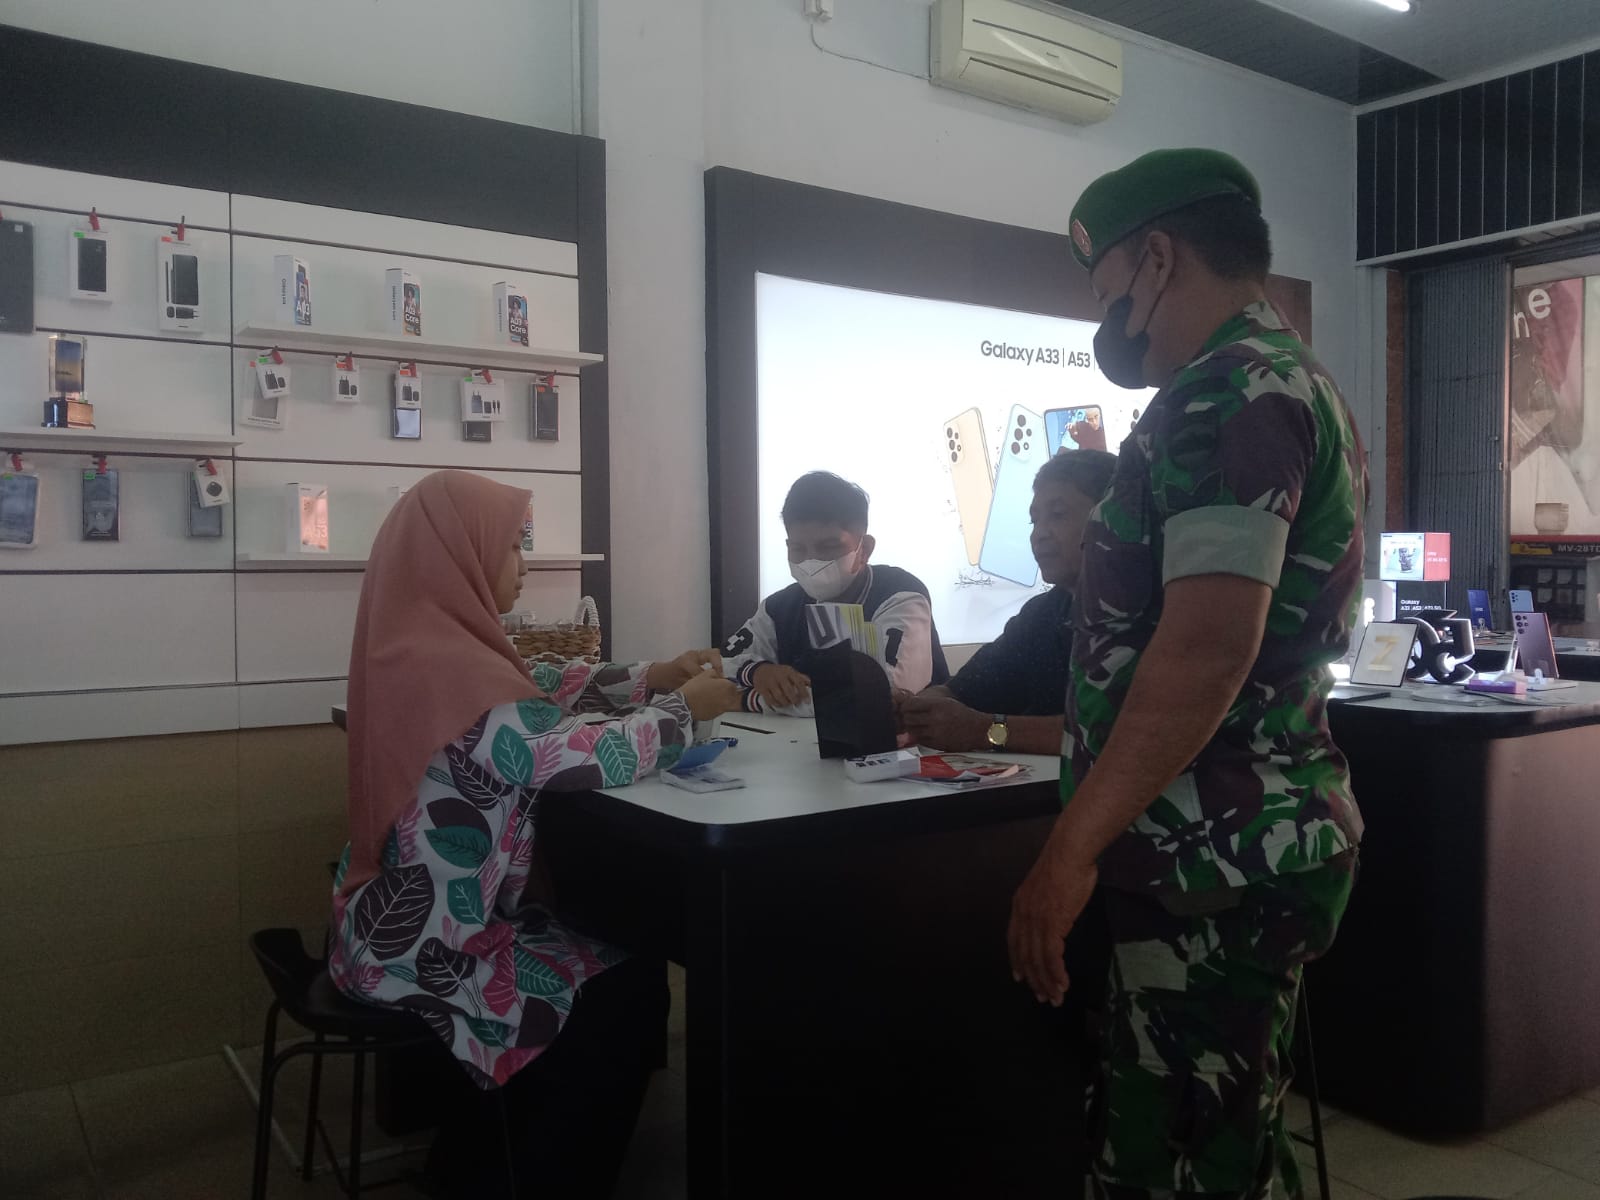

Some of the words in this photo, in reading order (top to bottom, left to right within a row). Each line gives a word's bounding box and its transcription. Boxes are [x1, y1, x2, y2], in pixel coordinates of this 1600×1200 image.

[510, 324, 527, 334] Core
[980, 340, 1034, 366] Galaxy
[1035, 347, 1060, 364] A33
[1067, 351, 1091, 368] A53
